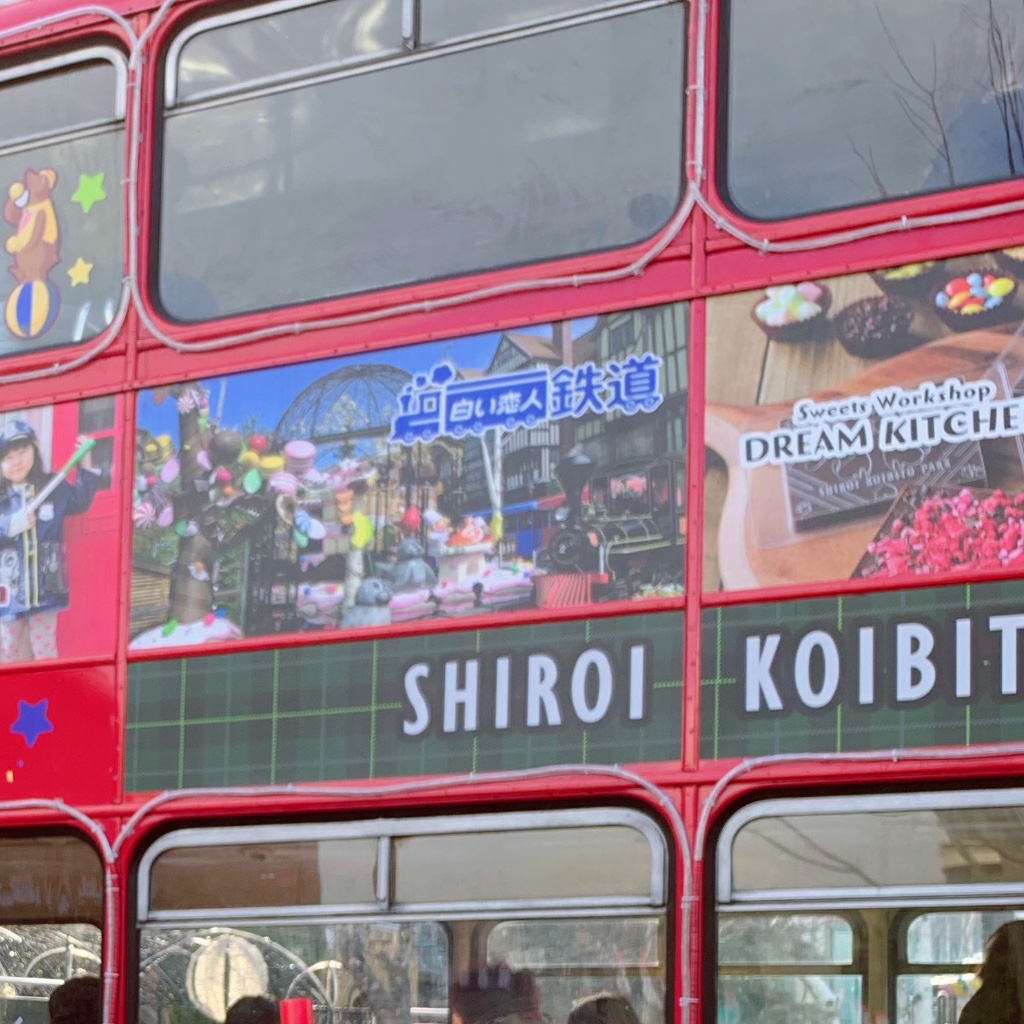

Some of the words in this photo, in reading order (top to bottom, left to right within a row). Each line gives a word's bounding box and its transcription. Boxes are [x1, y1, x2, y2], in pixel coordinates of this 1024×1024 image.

[797, 402, 868, 421] Sweets
[875, 384, 991, 411] Workshop
[745, 422, 870, 462] DREAM
[402, 645, 645, 735] SHIROI
